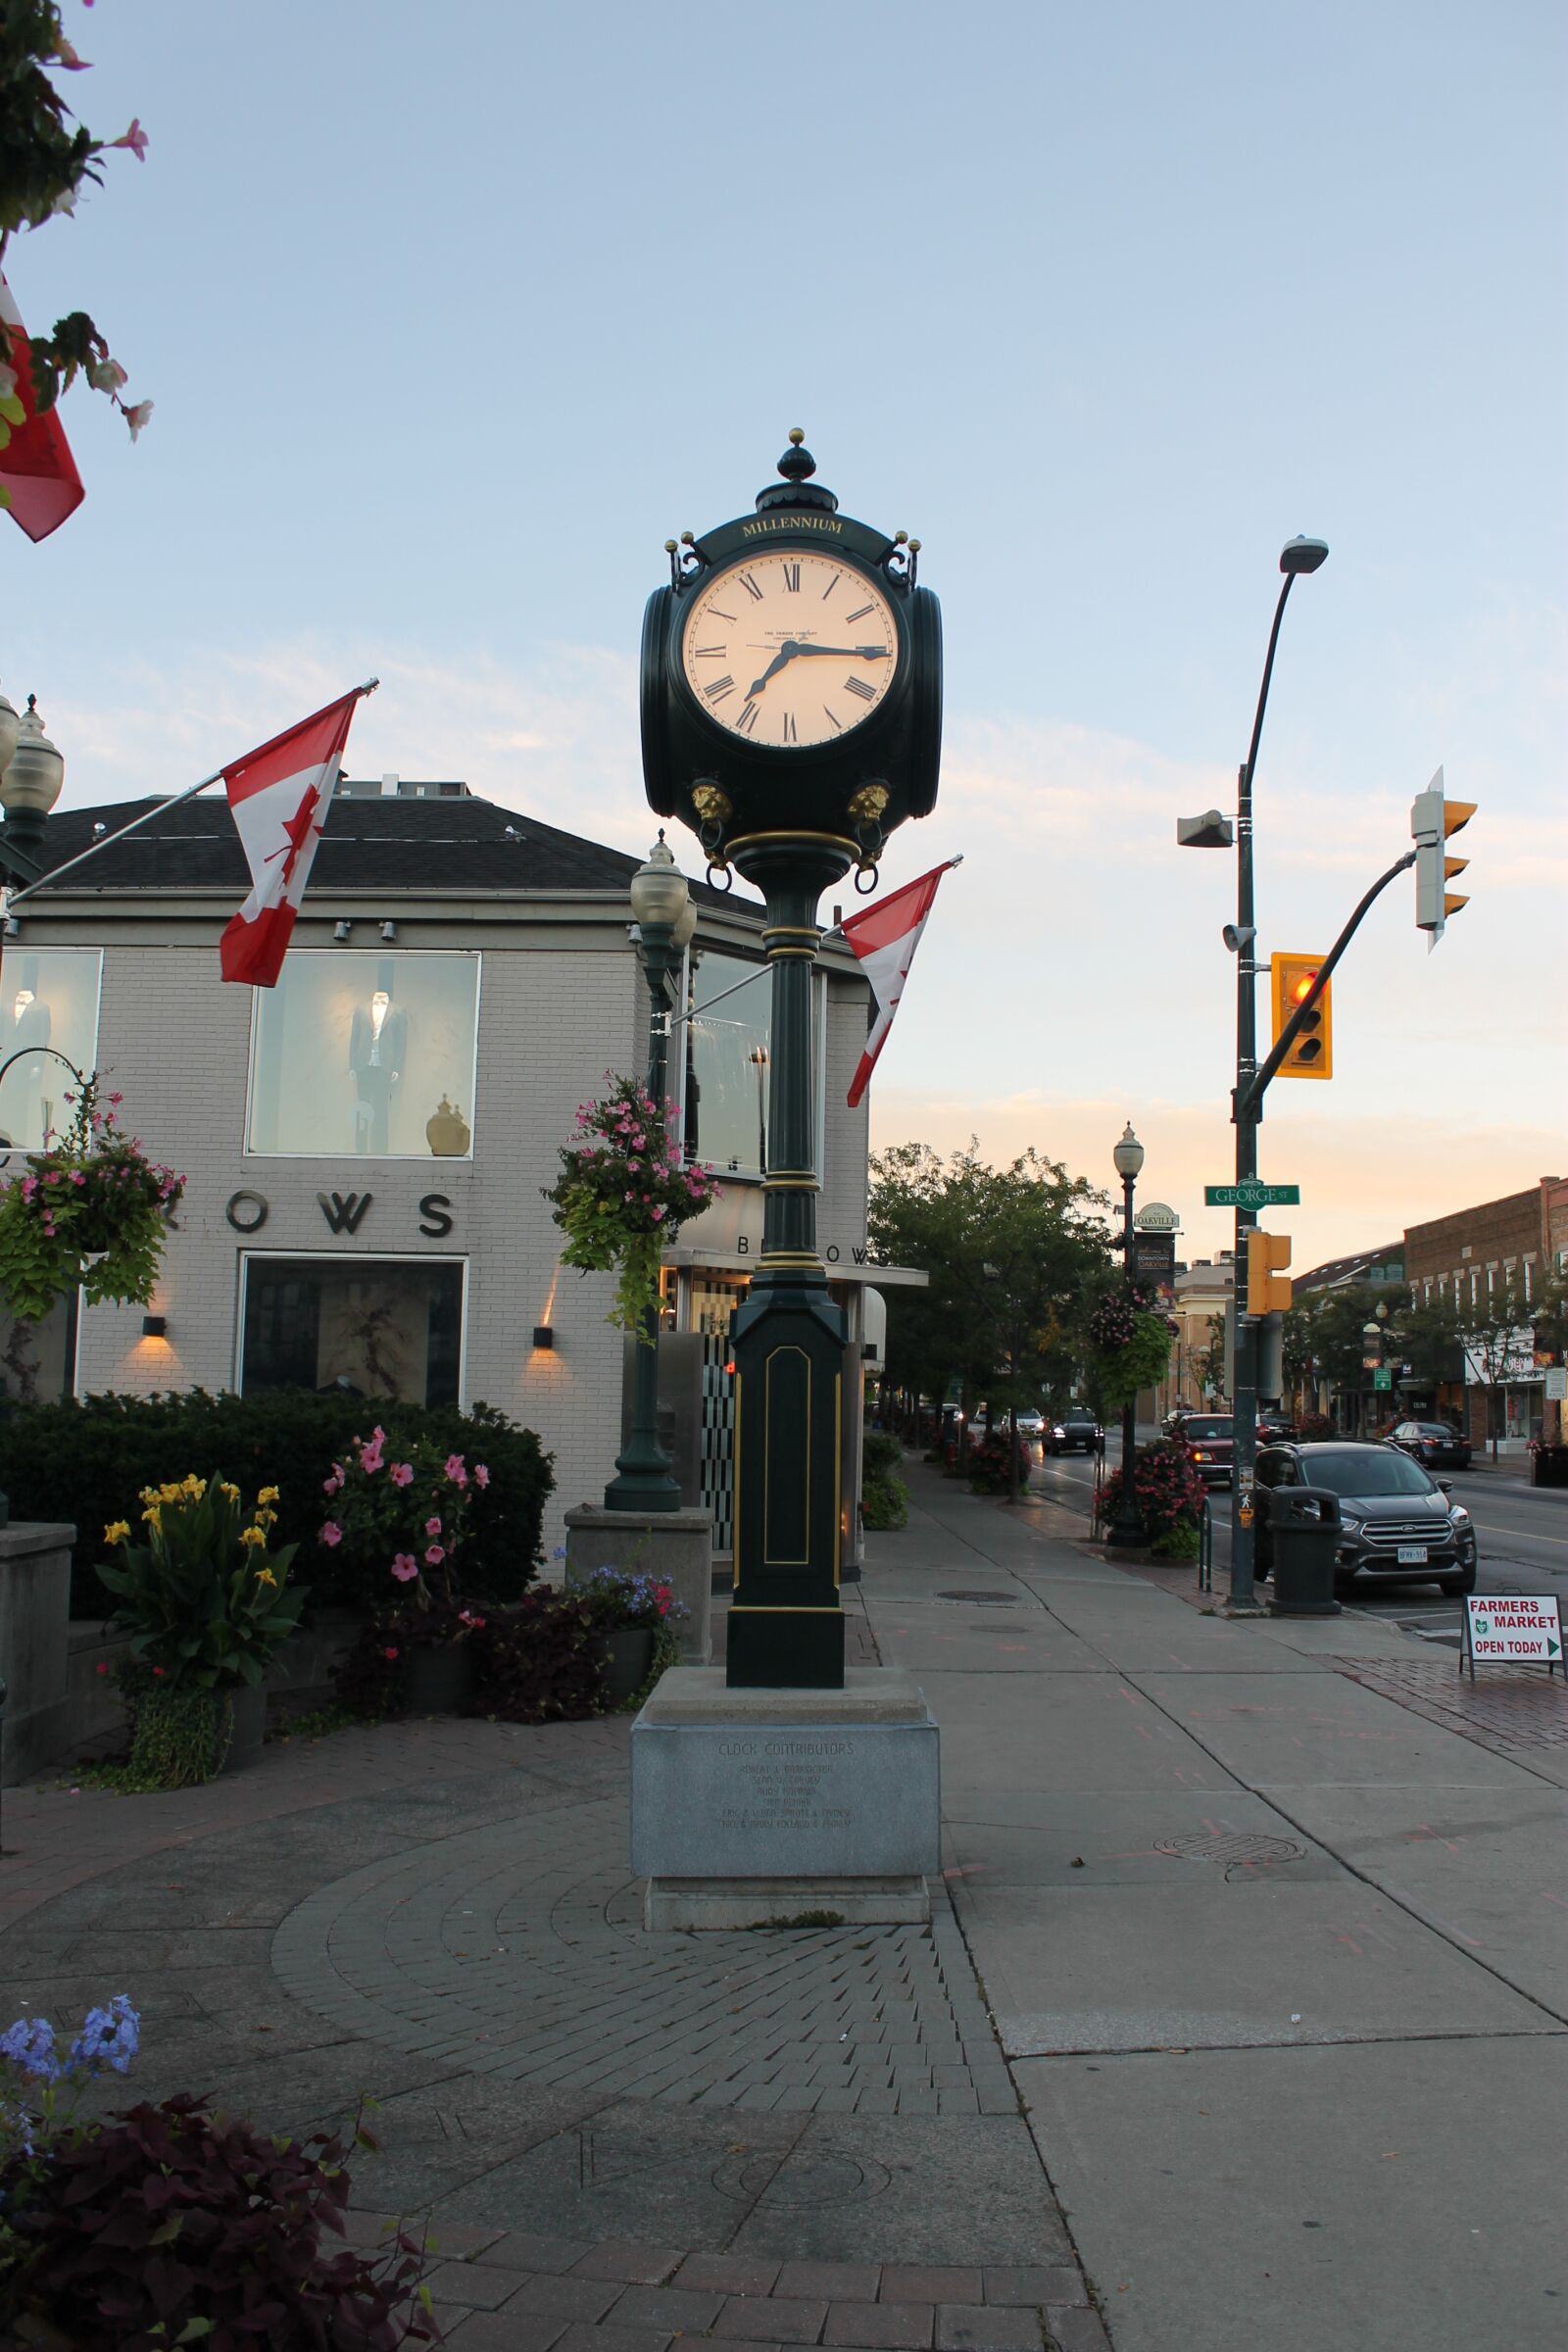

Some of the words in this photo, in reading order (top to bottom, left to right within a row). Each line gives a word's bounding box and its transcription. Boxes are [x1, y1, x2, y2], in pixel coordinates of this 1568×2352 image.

[742, 516, 843, 537] MILLENNIUM
[782, 564, 800, 592] XII
[738, 573, 763, 605] XI
[707, 604, 738, 627] X
[846, 604, 875, 623] II
[695, 643, 726, 658] IX
[703, 674, 737, 705] VIII
[735, 700, 760, 733] VII
[783, 711, 798, 742] VI
[1215, 1188, 1278, 1202] GEORGE
[1278, 1191, 1289, 1200] ST
[1137, 1216, 1176, 1226] OAKVILLE
[1470, 1600, 1539, 1613] FARMERS
[1494, 1616, 1556, 1628] MARKET
[1475, 1641, 1504, 1653] OPEN
[1507, 1642, 1543, 1653] TODAY
[718, 1742, 758, 1755] CLOCK
[764, 1742, 855, 1755] CONTRIBUTORS
